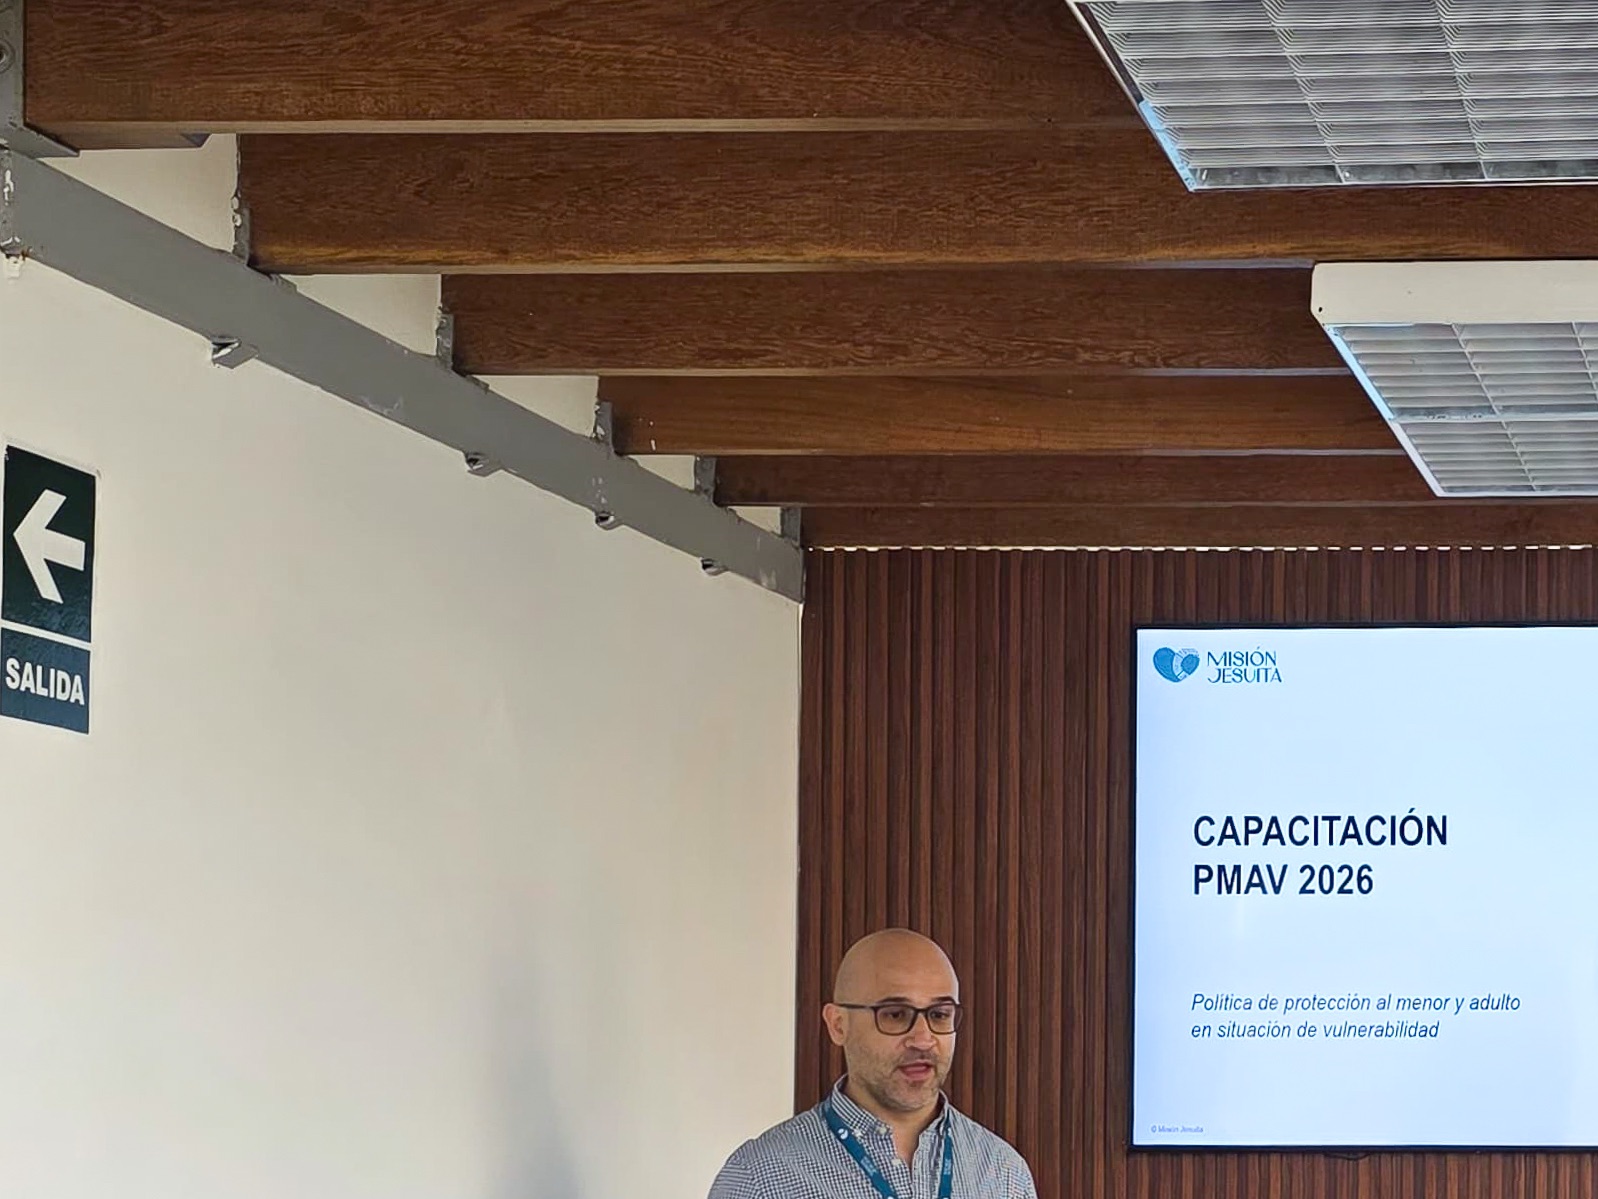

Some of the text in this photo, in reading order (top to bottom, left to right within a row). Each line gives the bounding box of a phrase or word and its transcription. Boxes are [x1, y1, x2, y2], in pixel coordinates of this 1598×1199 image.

[1207, 646, 1277, 667] MISIÓN
[5, 657, 85, 705] SALIDA
[1207, 667, 1282, 684] JESUITA
[1193, 808, 1448, 847] CAPACITACIÓN
[1194, 864, 1374, 895] PMAV 2026
[1191, 993, 1521, 1016] Política de protección al menor y adulto
[1191, 1021, 1440, 1039] en situación de vulnerabilidad
